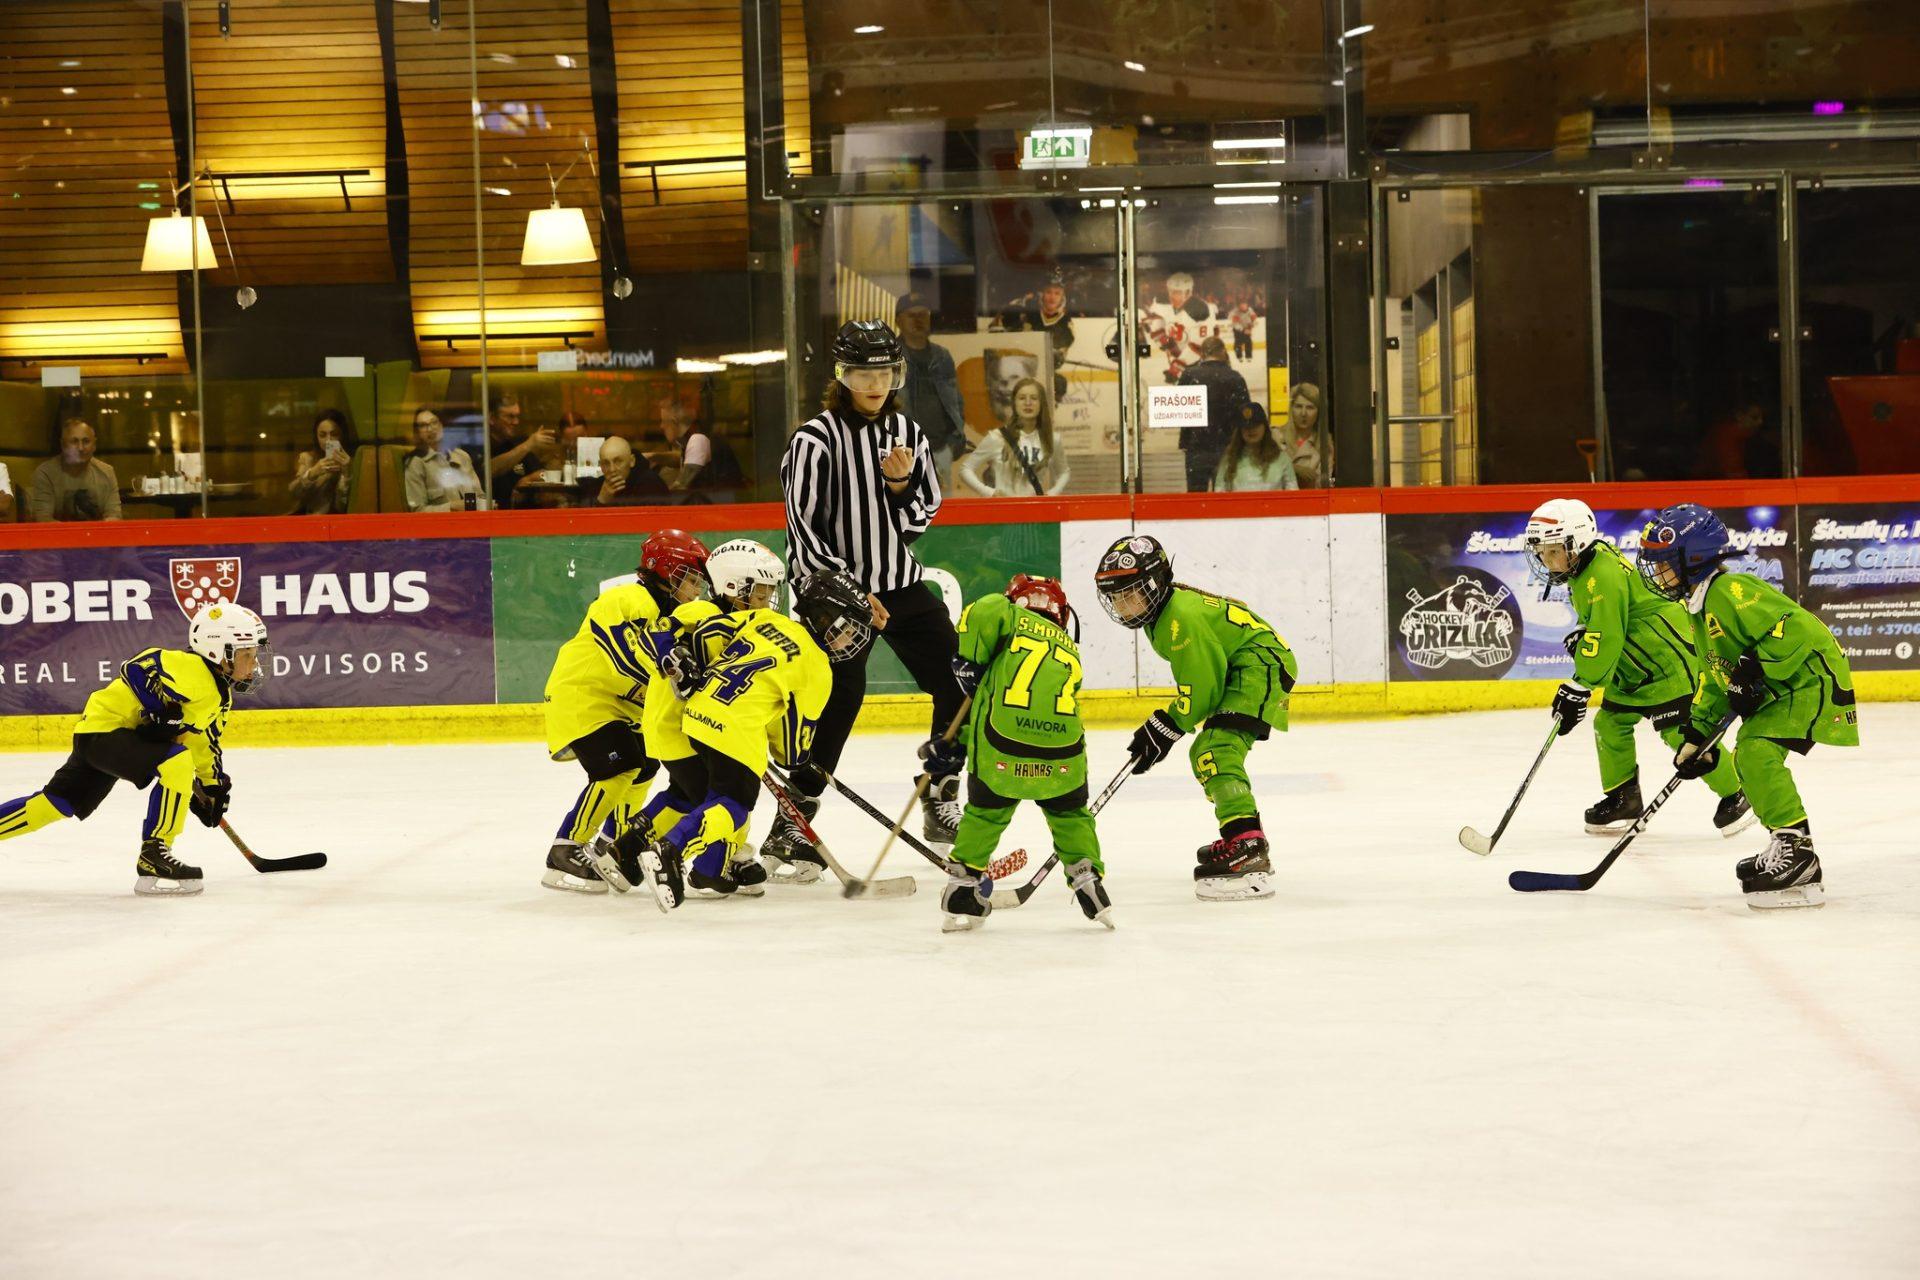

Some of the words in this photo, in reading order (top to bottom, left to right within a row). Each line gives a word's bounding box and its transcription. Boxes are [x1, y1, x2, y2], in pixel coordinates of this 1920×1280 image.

[1153, 393, 1202, 407] PRAŠOME
[1808, 548, 1854, 571] HC
[0, 578, 154, 626] OBER
[260, 570, 430, 617] HAUS
[1423, 613, 1463, 625] HOCKEY
[1835, 611, 1870, 620] apranga
[1581, 631, 1602, 658] 5
[272, 651, 429, 677] DVISORS
[698, 636, 777, 706] 24
[1002, 634, 1083, 717] 77
[1015, 716, 1067, 734] VAIVORA
